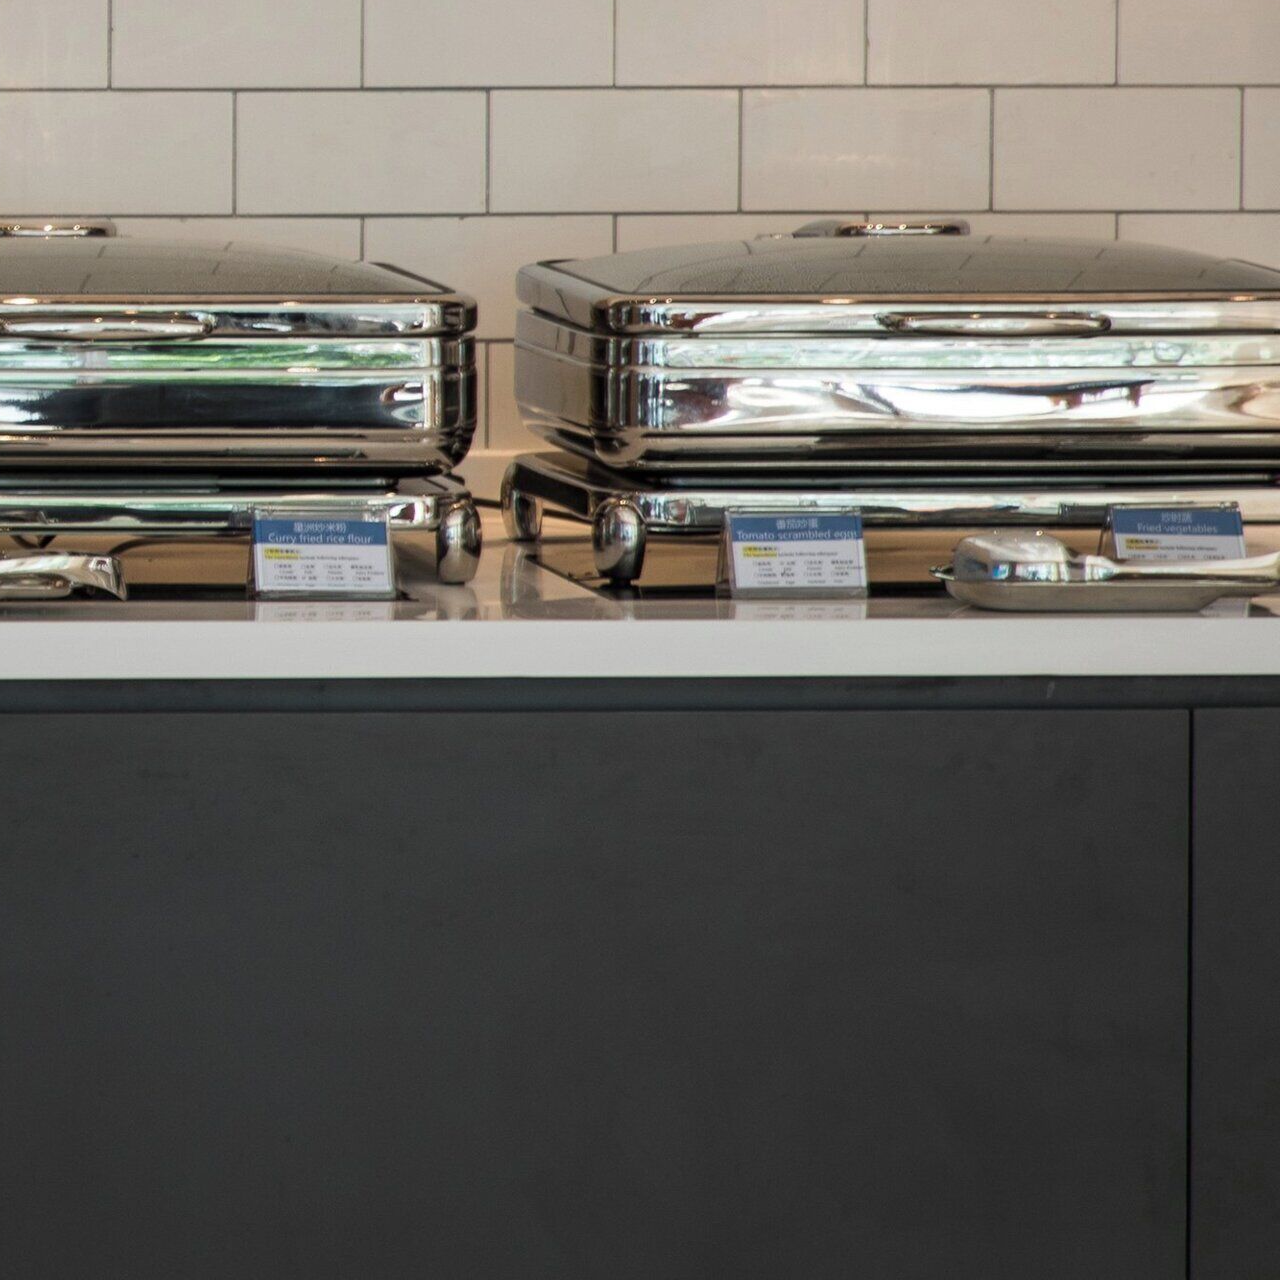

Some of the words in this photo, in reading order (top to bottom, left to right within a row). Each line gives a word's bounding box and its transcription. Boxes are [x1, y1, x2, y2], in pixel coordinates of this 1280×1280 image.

[736, 530, 775, 540] Tomato
[778, 529, 831, 540] scrambled
[1137, 523, 1162, 533] Fried
[1163, 524, 1218, 535] vegetables
[268, 532, 296, 545] Curry
[299, 533, 323, 543] fried
[326, 533, 345, 543] rice
[347, 533, 372, 544] flour
